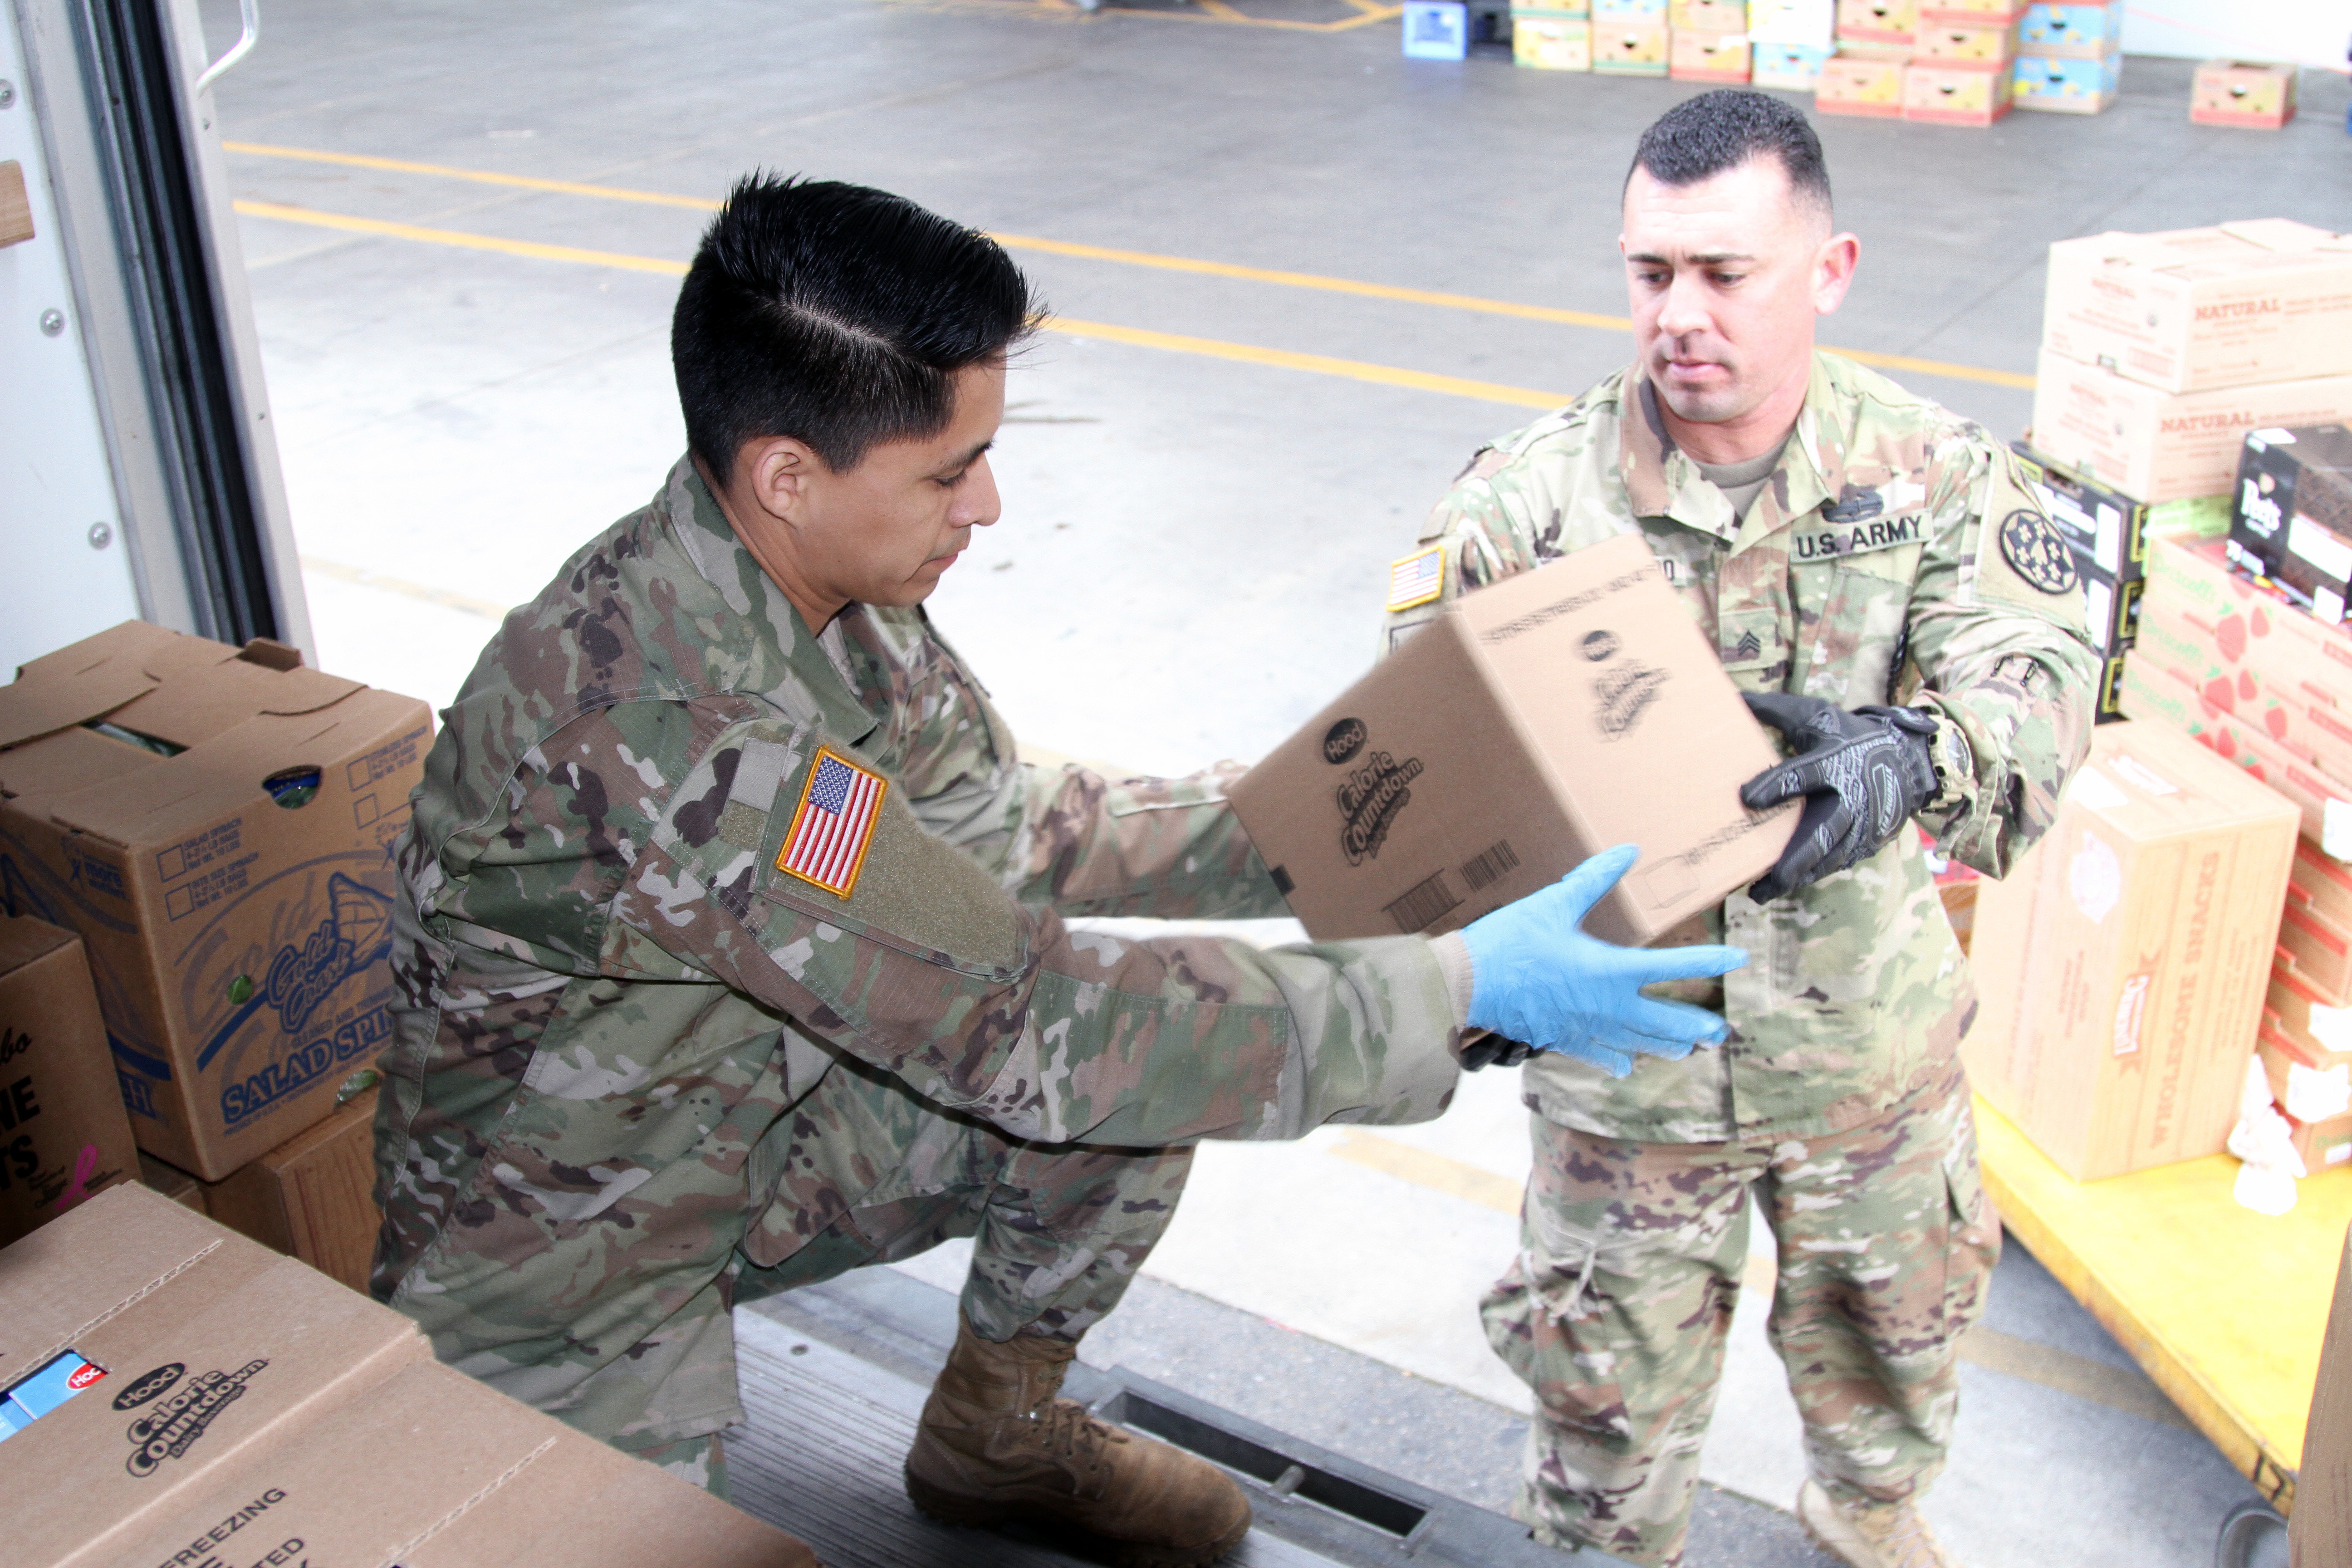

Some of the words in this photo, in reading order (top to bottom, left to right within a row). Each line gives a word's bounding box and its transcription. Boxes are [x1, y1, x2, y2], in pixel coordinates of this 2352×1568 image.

[2195, 298, 2282, 322] NATURAL
[2161, 412, 2255, 433] NATURAL
[1797, 533, 1840, 558] U.S.
[1850, 515, 1922, 549] ARMY
[1325, 722, 1363, 761] Hood
[1338, 751, 1394, 820] Calorie
[1342, 758, 1424, 866] Countdown
[267, 921, 337, 1007] Gold
[281, 940, 351, 1031] Coast
[2149, 973, 2198, 1150] WHOLESOME
[2183, 851, 2220, 965] SNACKS
[222, 1039, 332, 1123] SALAD
[118, 1367, 181, 1407] Hood
[126, 1360, 269, 1477] Countdown
[127, 1371, 223, 1444] Calorie
